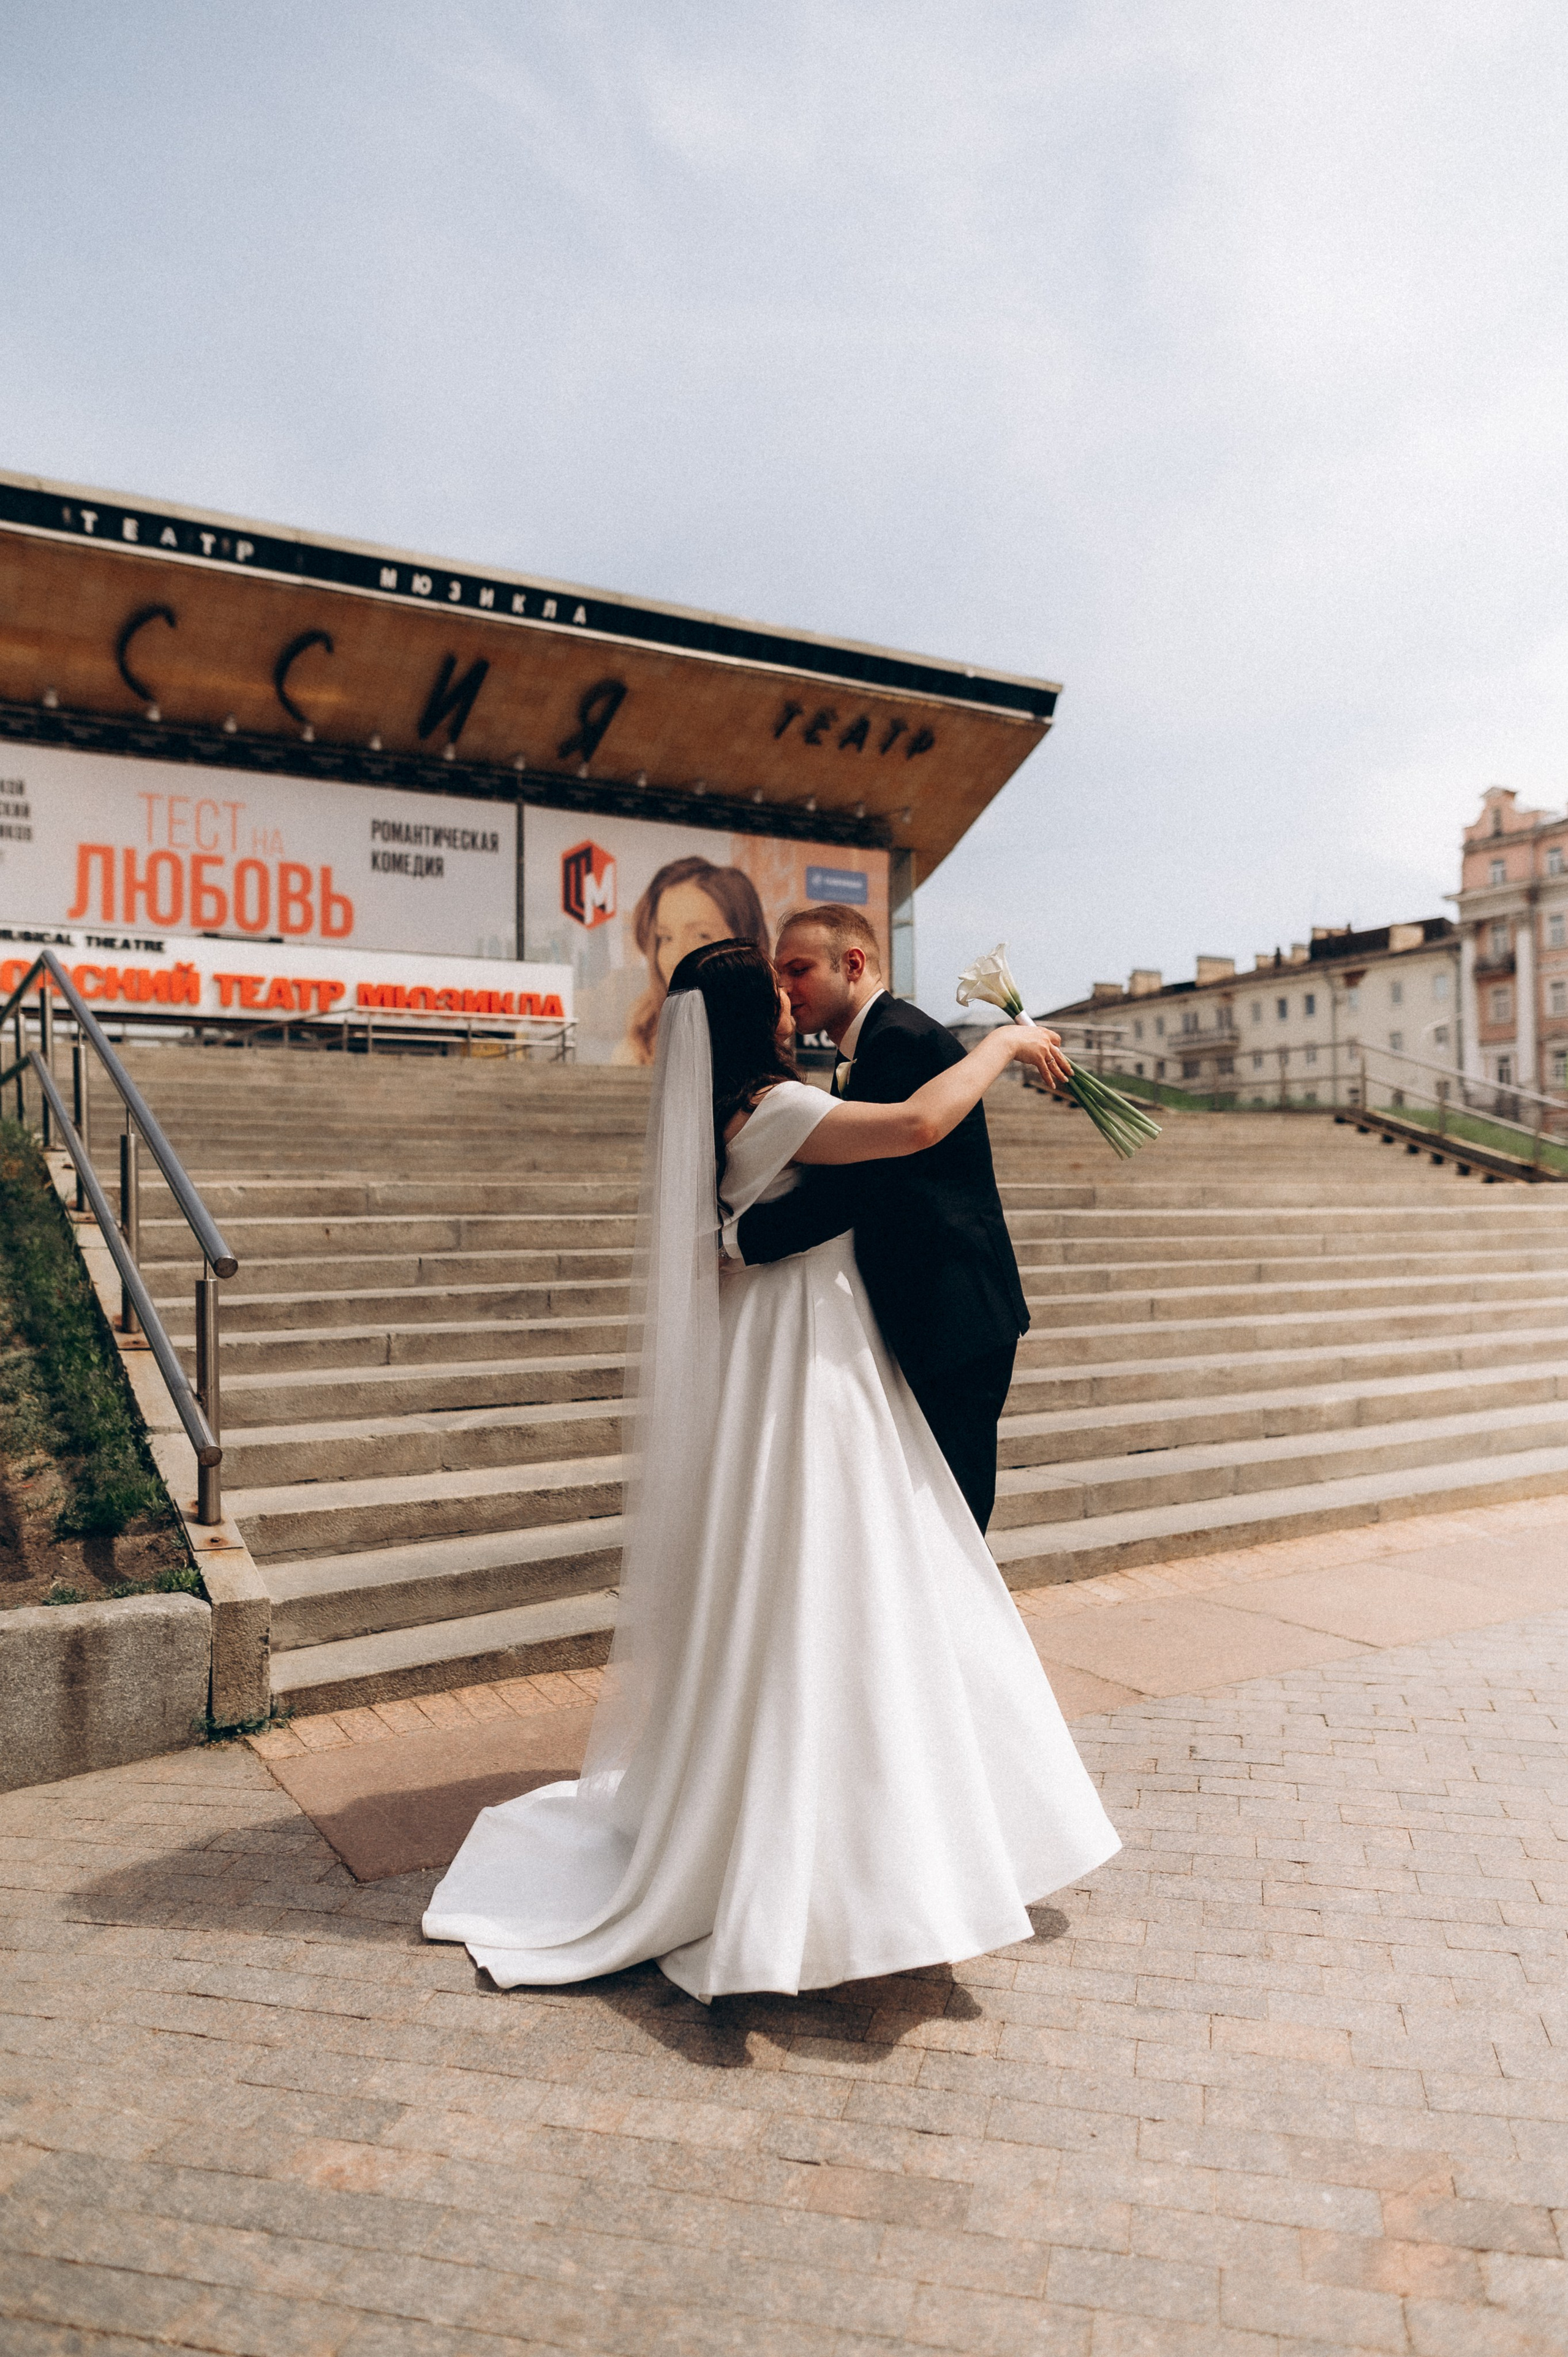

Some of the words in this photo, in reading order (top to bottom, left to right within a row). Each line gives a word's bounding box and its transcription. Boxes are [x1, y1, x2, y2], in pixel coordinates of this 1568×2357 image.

[80, 509, 254, 562] ТЕАТР
[379, 566, 587, 625] МЮЗИКЛА
[773, 701, 935, 760] ТЕАТР
[138, 792, 246, 853] ТЕСТ
[252, 826, 284, 857] НА
[371, 819, 499, 853] РОМАНТИЧЕСКАЯ
[371, 850, 443, 878] КОМЕДИЯ
[67, 842, 354, 938] ЛЮБОВЬ
[86, 935, 164, 952] THEATRE
[213, 973, 345, 1012] ТЕАТР
[357, 983, 564, 1017] МЮЗИКЛА
